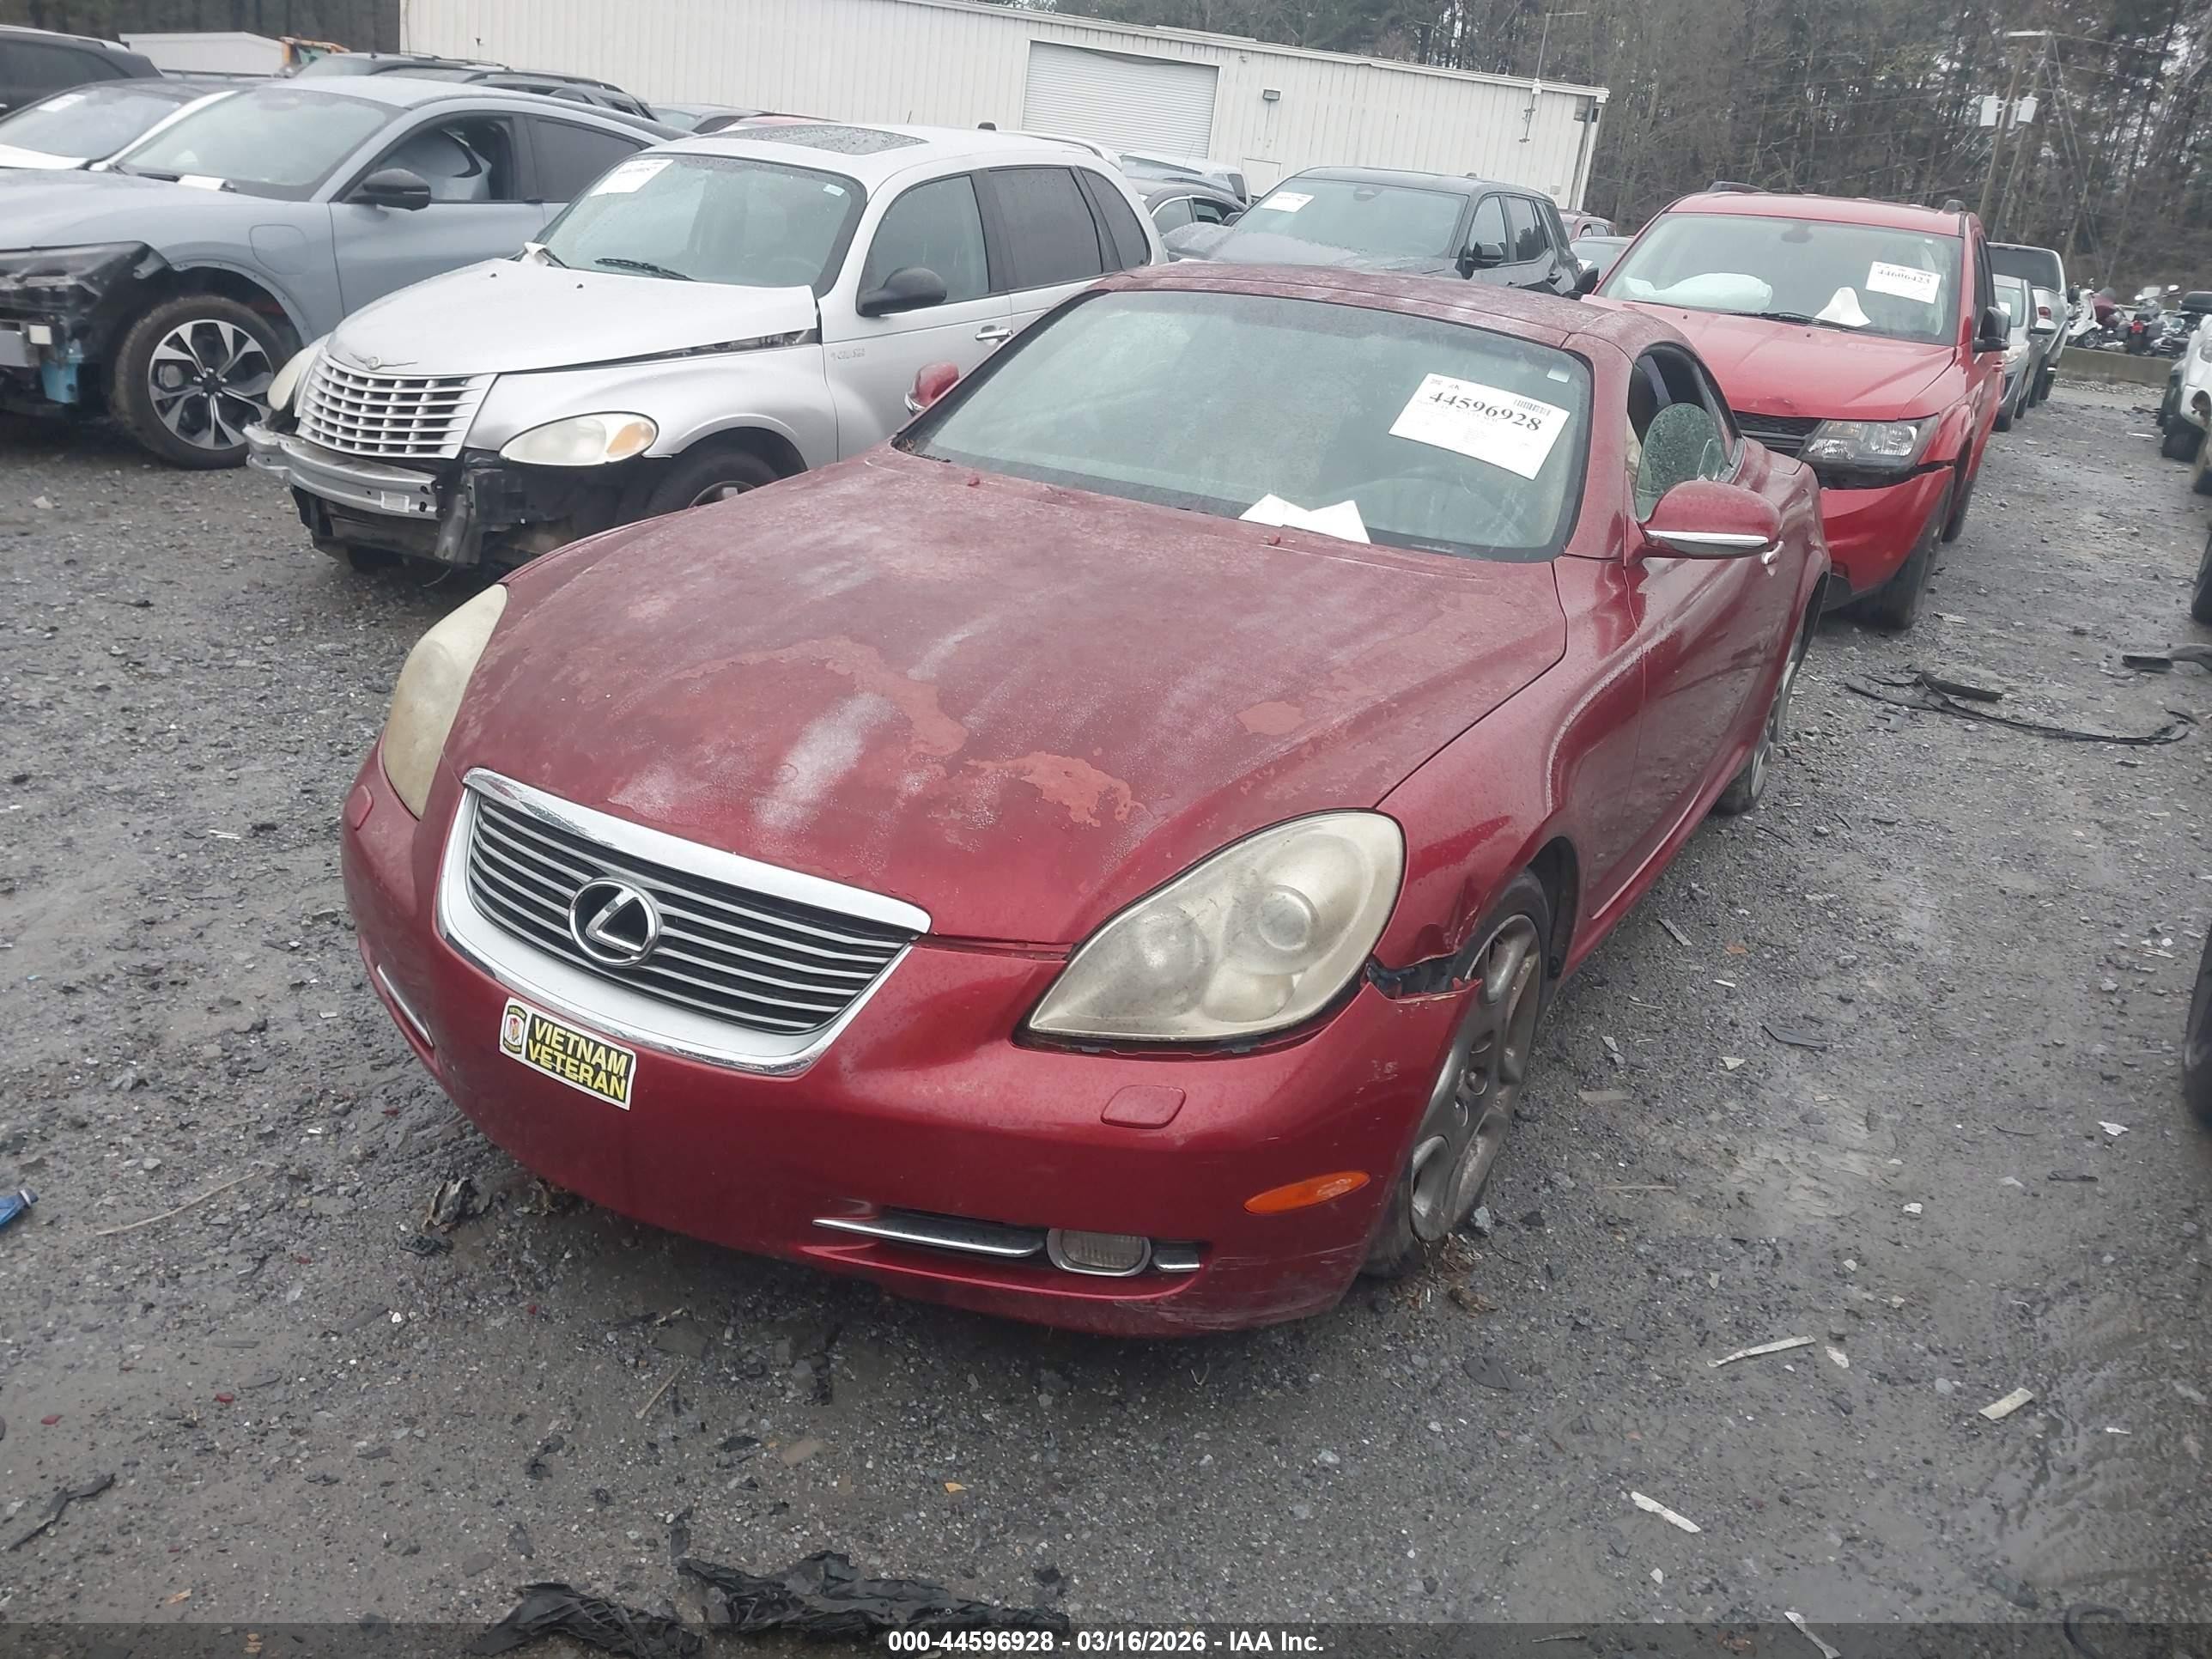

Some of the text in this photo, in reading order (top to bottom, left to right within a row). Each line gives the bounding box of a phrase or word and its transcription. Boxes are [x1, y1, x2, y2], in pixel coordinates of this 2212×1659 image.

[1429, 391, 1542, 431] 44596928
[527, 1038, 627, 1101] VETERAN
[533, 1017, 628, 1077] VIETNAM
